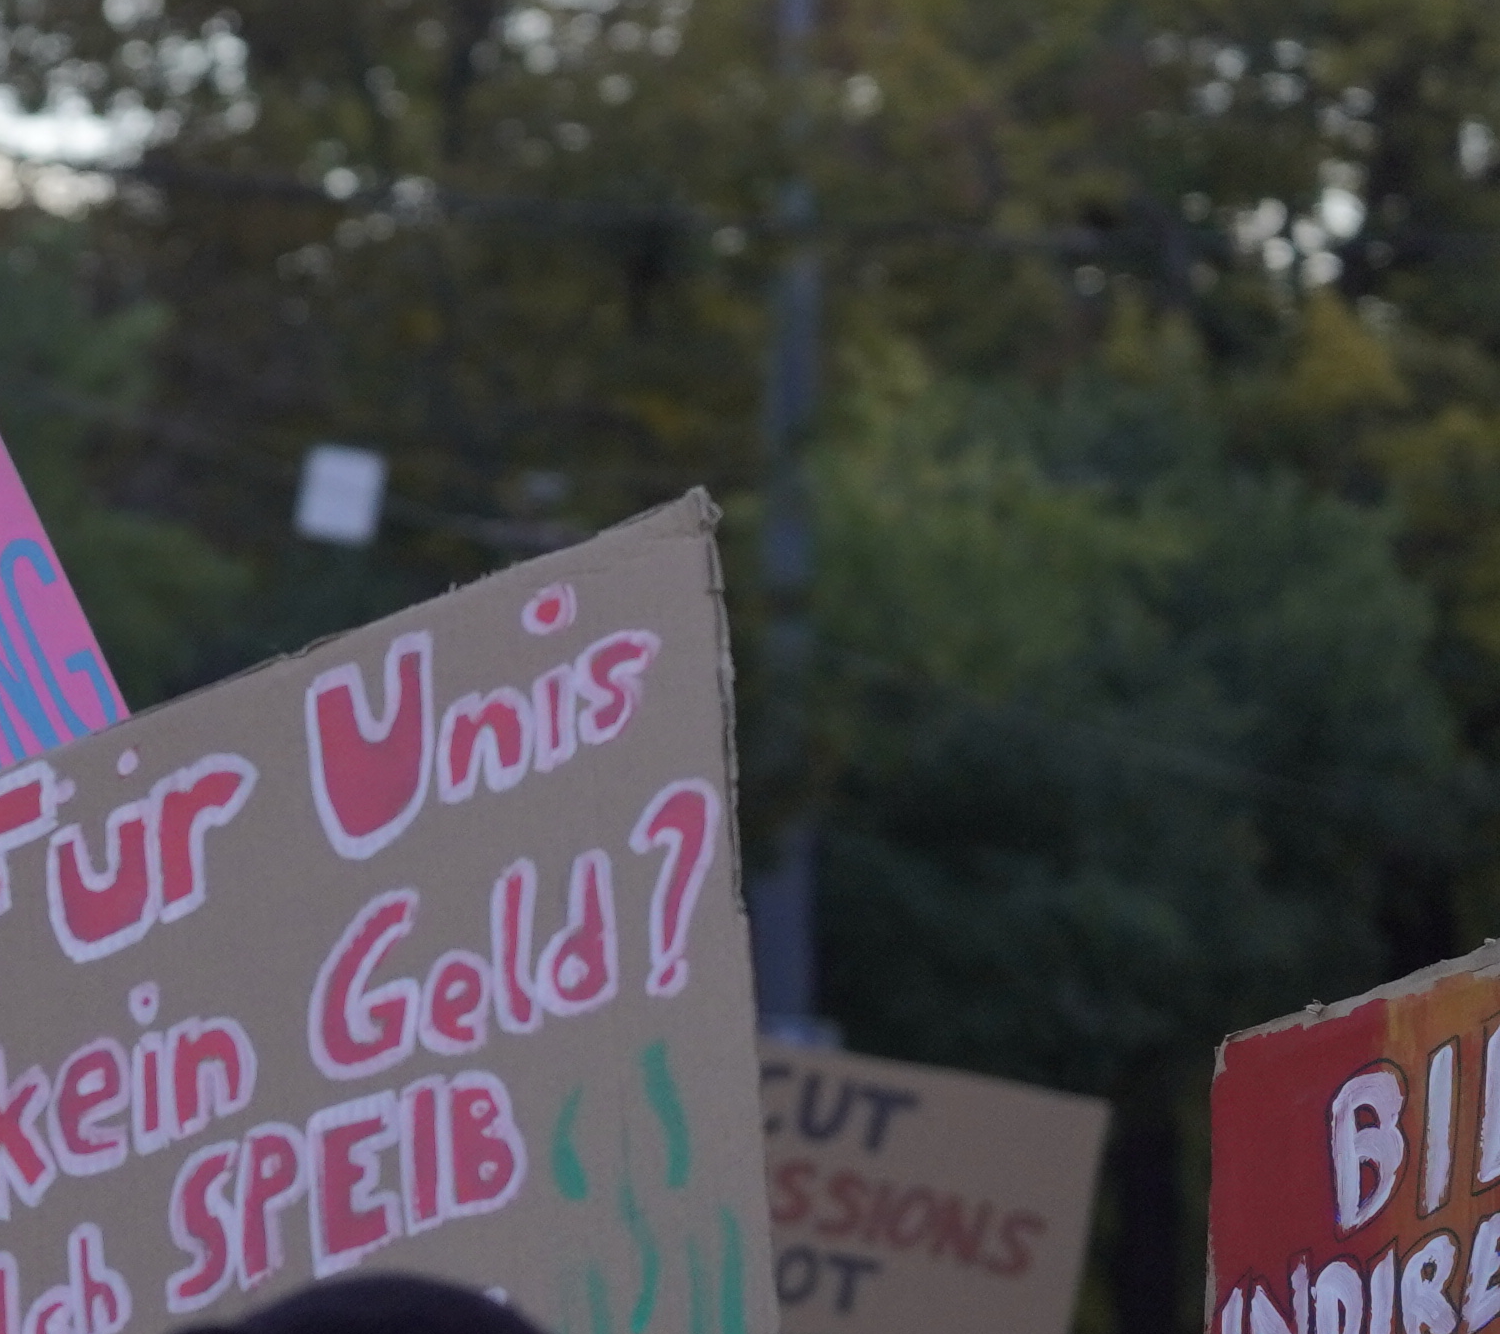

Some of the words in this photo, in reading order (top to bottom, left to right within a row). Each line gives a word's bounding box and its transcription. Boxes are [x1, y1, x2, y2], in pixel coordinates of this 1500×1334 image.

[306, 583, 661, 859] Unis
[308, 778, 721, 1081] Geld?
[167, 1071, 528, 1313] SPEIB
